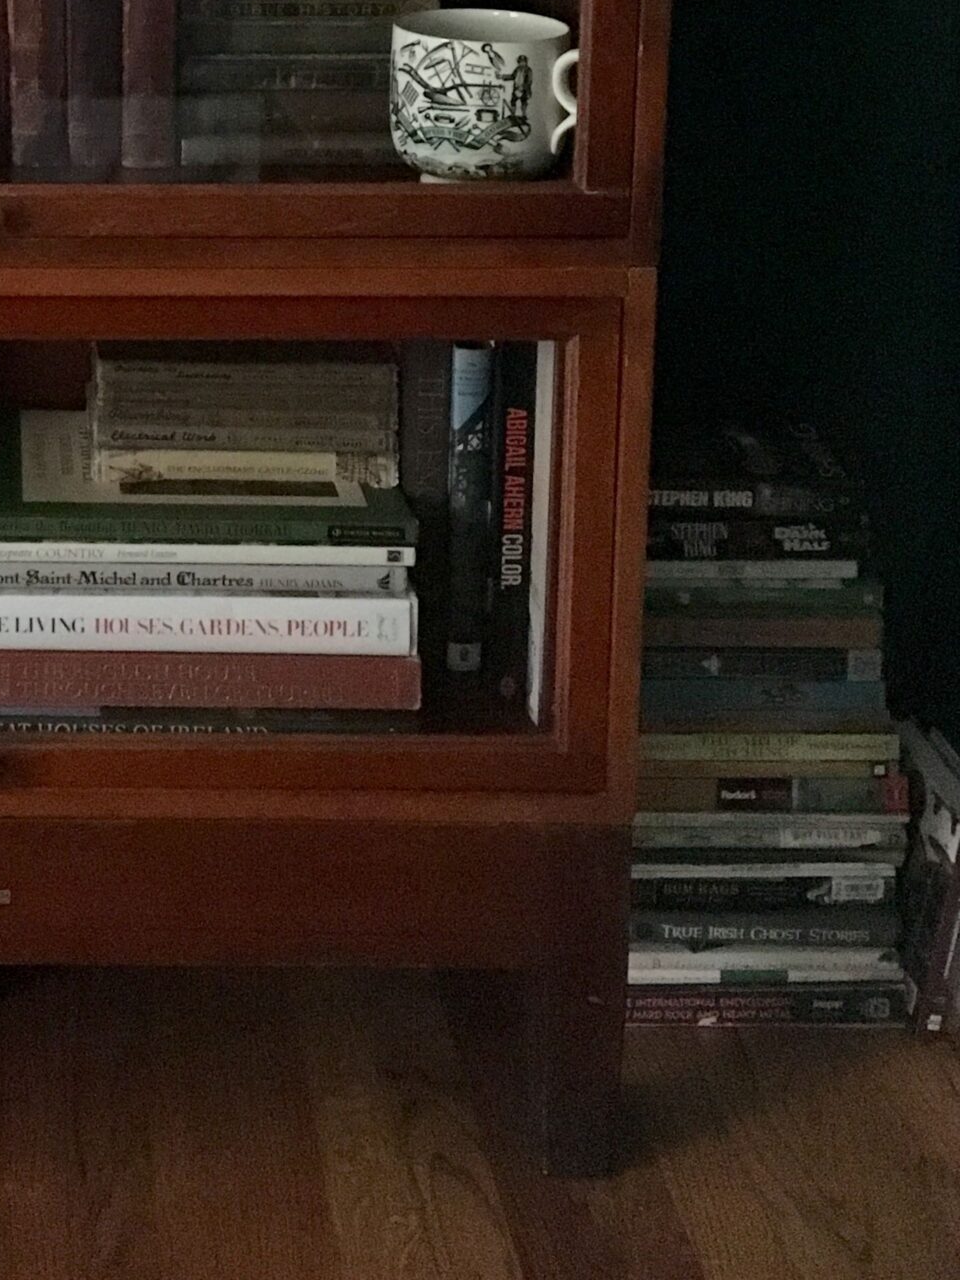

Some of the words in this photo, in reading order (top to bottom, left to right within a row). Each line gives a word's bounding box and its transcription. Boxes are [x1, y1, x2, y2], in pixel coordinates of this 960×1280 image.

[298, 3, 385, 16] HISTORY
[110, 429, 176, 443] Electrical
[182, 431, 217, 443] Work
[504, 407, 528, 471] ABIGAIL
[502, 474, 526, 530] AHERN
[713, 489, 754, 508] KING
[670, 522, 729, 540] STEPHEN
[36, 548, 105, 559] COUNTRY
[683, 539, 717, 557] KING
[782, 539, 832, 552] HALF
[500, 533, 524, 590] COLOR.
[140, 570, 171, 587] and
[176, 571, 254, 588] Chartres
[259, 578, 300, 587] HENRY
[304, 579, 344, 589] ADAMS
[14, 616, 86, 634] LIVING
[286, 619, 369, 638] PEOPLE
[661, 923, 702, 940] TRUE
[708, 926, 746, 940] IRISH
[750, 927, 802, 941] GHOST
[809, 928, 870, 943] STORIES
[635, 998, 715, 1008] INTERNATIONAL
[633, 1010, 661, 1019] HARD
[664, 1010, 692, 1019] ROCK
